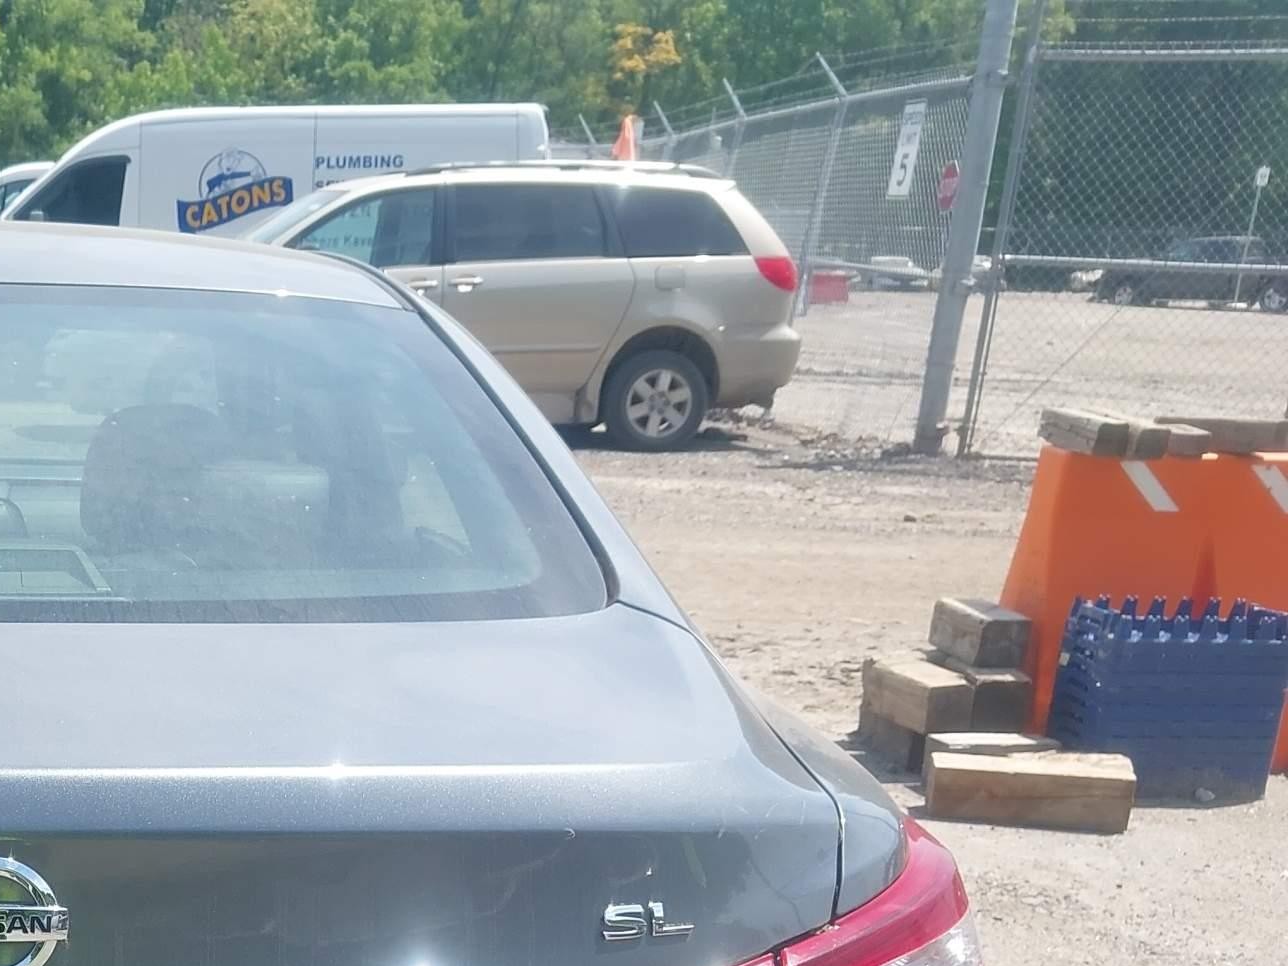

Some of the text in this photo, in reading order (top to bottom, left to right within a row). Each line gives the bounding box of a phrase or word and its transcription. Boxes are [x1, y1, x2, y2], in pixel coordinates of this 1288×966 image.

[315, 155, 404, 169] PLUMBING
[896, 152, 909, 186] 5
[185, 179, 286, 228] CATONS
[602, 901, 696, 941] SL
